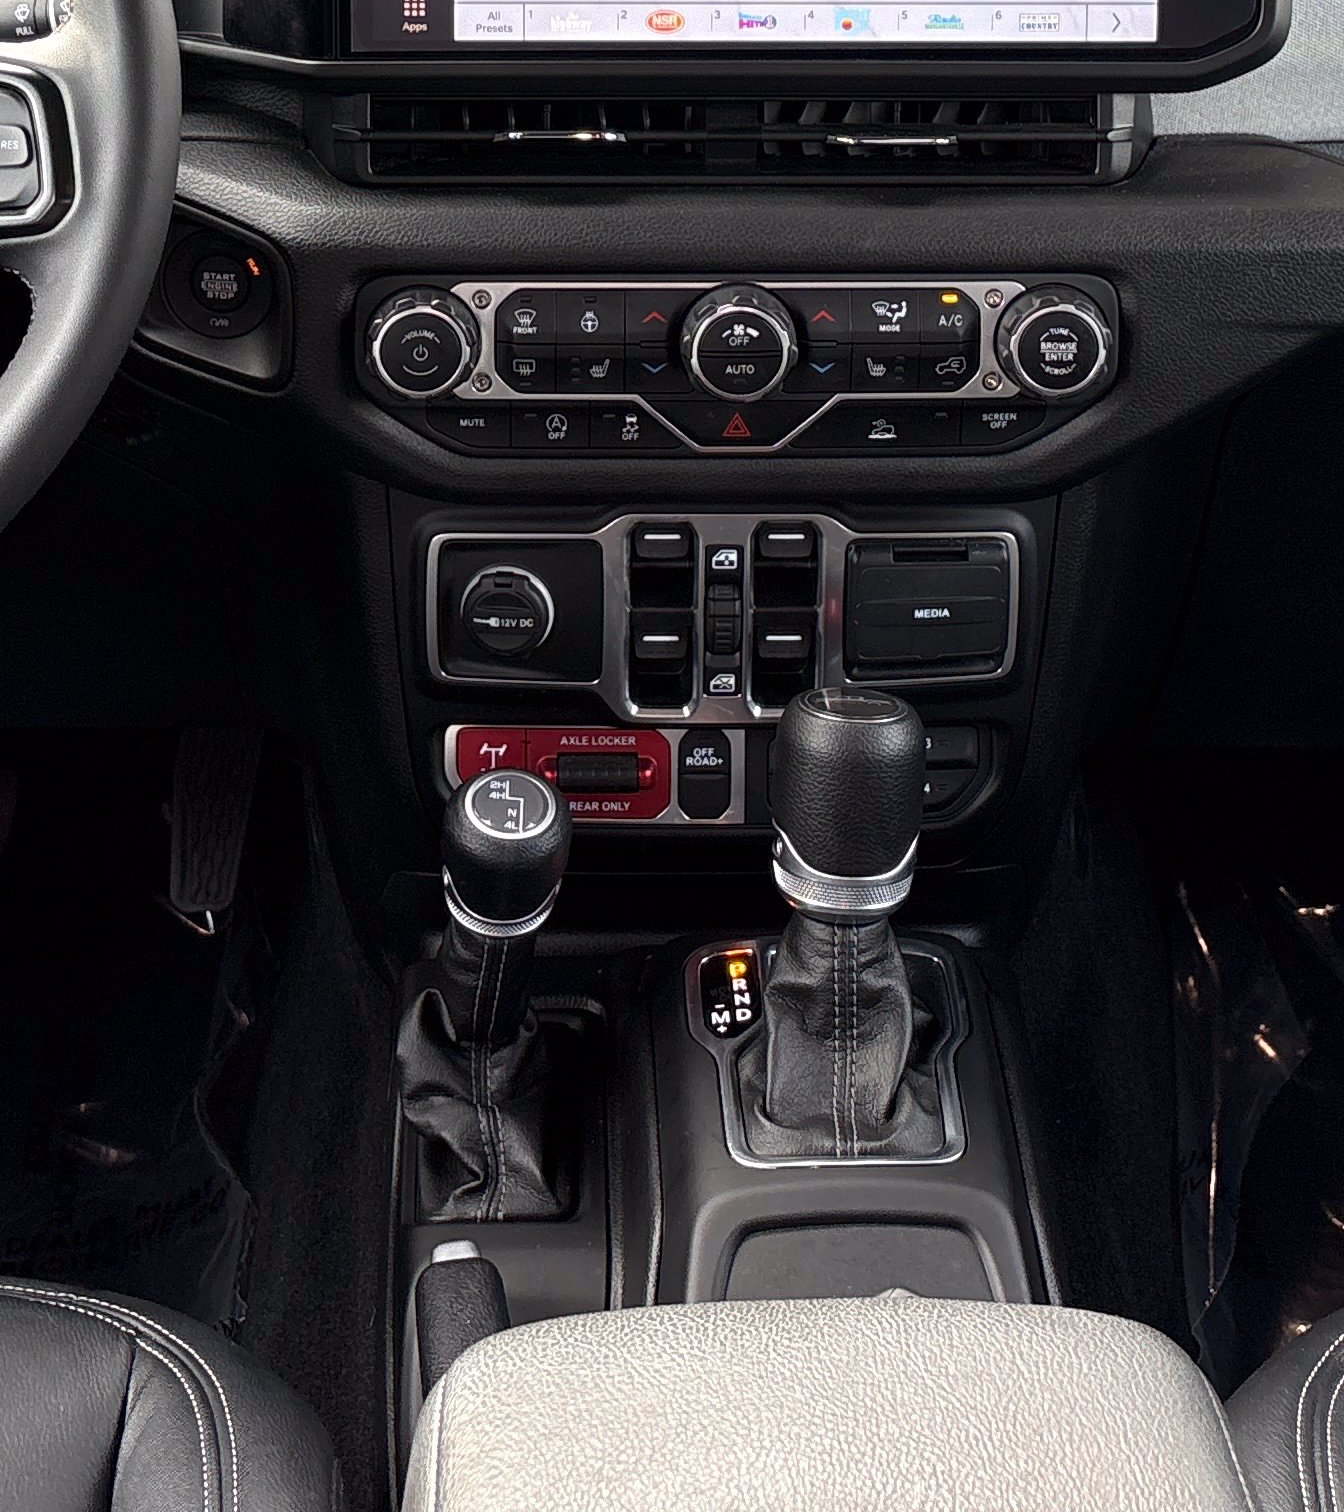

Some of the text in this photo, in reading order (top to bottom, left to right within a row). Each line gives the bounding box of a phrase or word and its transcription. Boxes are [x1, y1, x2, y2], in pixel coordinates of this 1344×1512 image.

[487, 11, 501, 22] All
[529, 11, 533, 19] 1
[621, 11, 628, 19] 2
[714, 11, 720, 19] 3
[808, 11, 814, 20] 4
[901, 11, 908, 20] 5
[995, 11, 1002, 20] 6
[402, 21, 428, 33] Apps
[476, 22, 513, 34] Presets
[0, 137, 20, 151] RES
[203, 272, 236, 281] START
[939, 314, 963, 328] A/C
[513, 325, 537, 335] FRONT
[879, 324, 901, 333] MODE
[1050, 328, 1069, 336] TUNE
[729, 336, 749, 346] OFF
[1041, 341, 1078, 351] BROWSE
[1045, 352, 1074, 362] ENTER
[725, 364, 755, 375] AUTO
[1044, 364, 1074, 376] SCROLL
[982, 413, 1017, 421] SCREEN
[459, 418, 486, 428] MUTE
[990, 421, 1008, 429] OFF
[548, 431, 566, 440] OFF
[622, 432, 639, 441] OFF
[914, 608, 950, 619] MEDIA
[500, 617, 534, 628] 12V DC
[559, 735, 637, 746] AXLE LOCKER
[693, 747, 714, 759] OFF
[686, 756, 725, 767] ROAD+
[489, 780, 506, 790] 2H
[488, 791, 506, 800] 4H
[569, 801, 631, 812] REAR ONLY
[507, 808, 517, 817] N
[504, 821, 518, 830] 4L
[729, 962, 747, 978] P
[733, 978, 747, 992] R
[734, 992, 749, 1005] N
[712, 1010, 731, 1026] M
[736, 1008, 751, 1022] D
